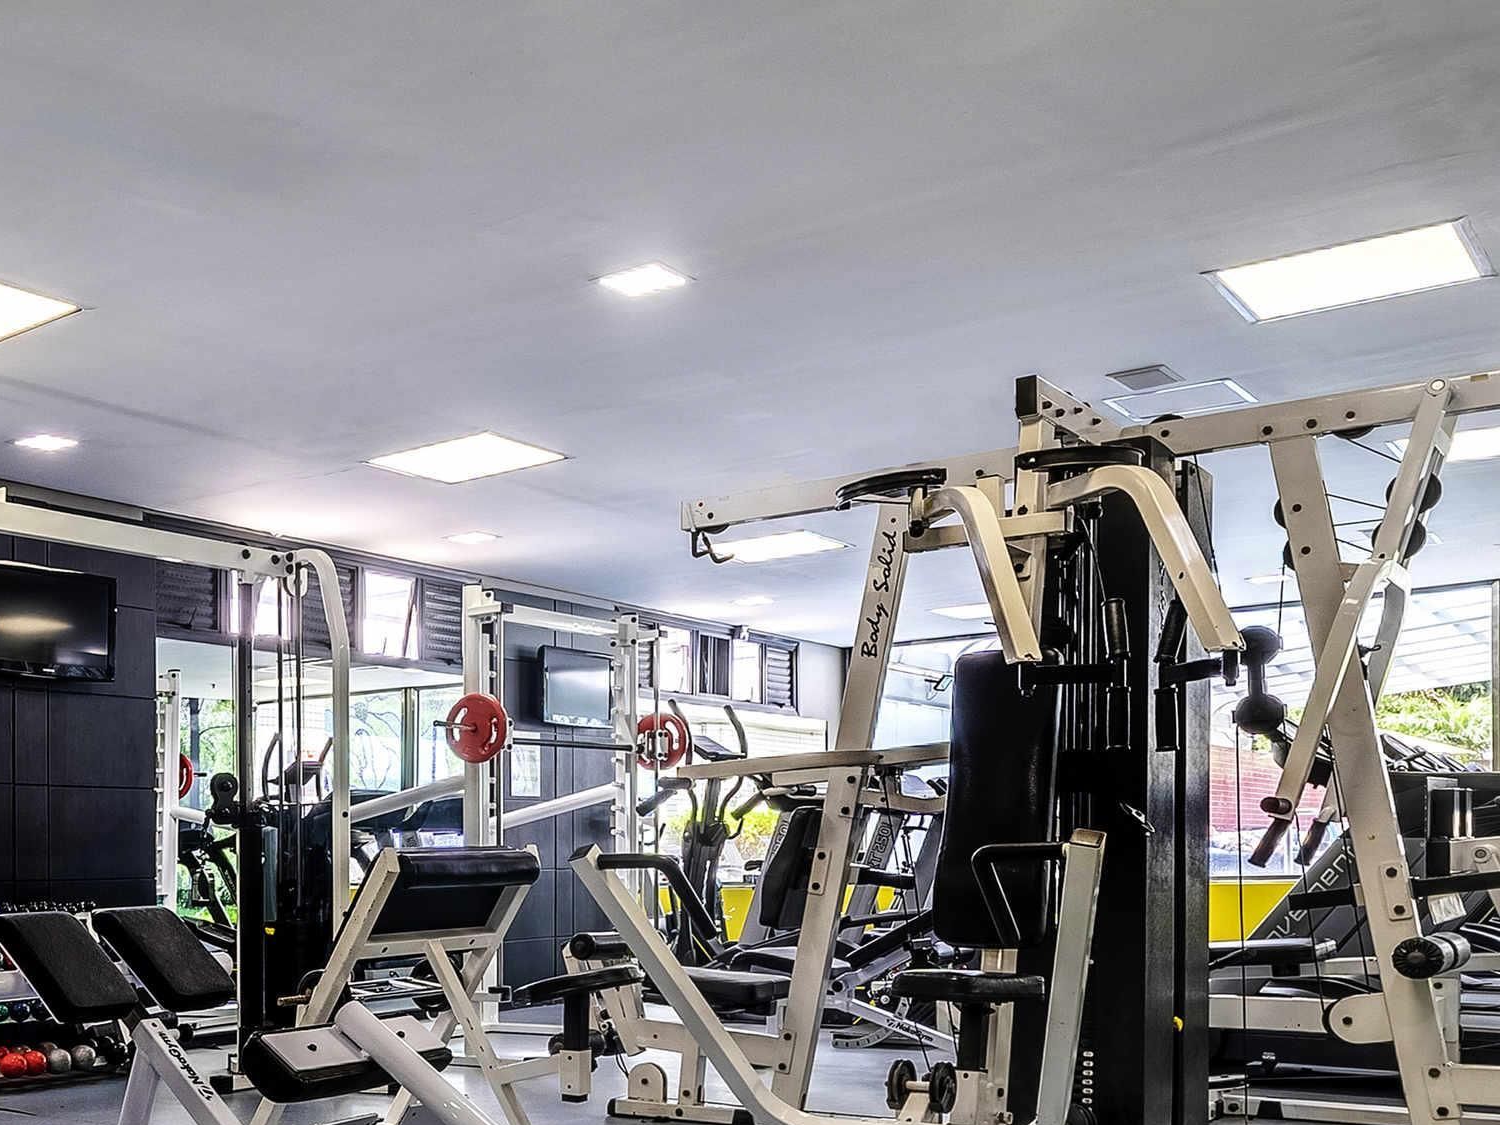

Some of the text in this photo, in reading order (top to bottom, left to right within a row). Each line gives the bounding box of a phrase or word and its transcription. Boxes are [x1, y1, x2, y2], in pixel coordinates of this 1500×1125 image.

[861, 531, 897, 658] Body Solid
[158, 1031, 204, 1085] NakaGym
